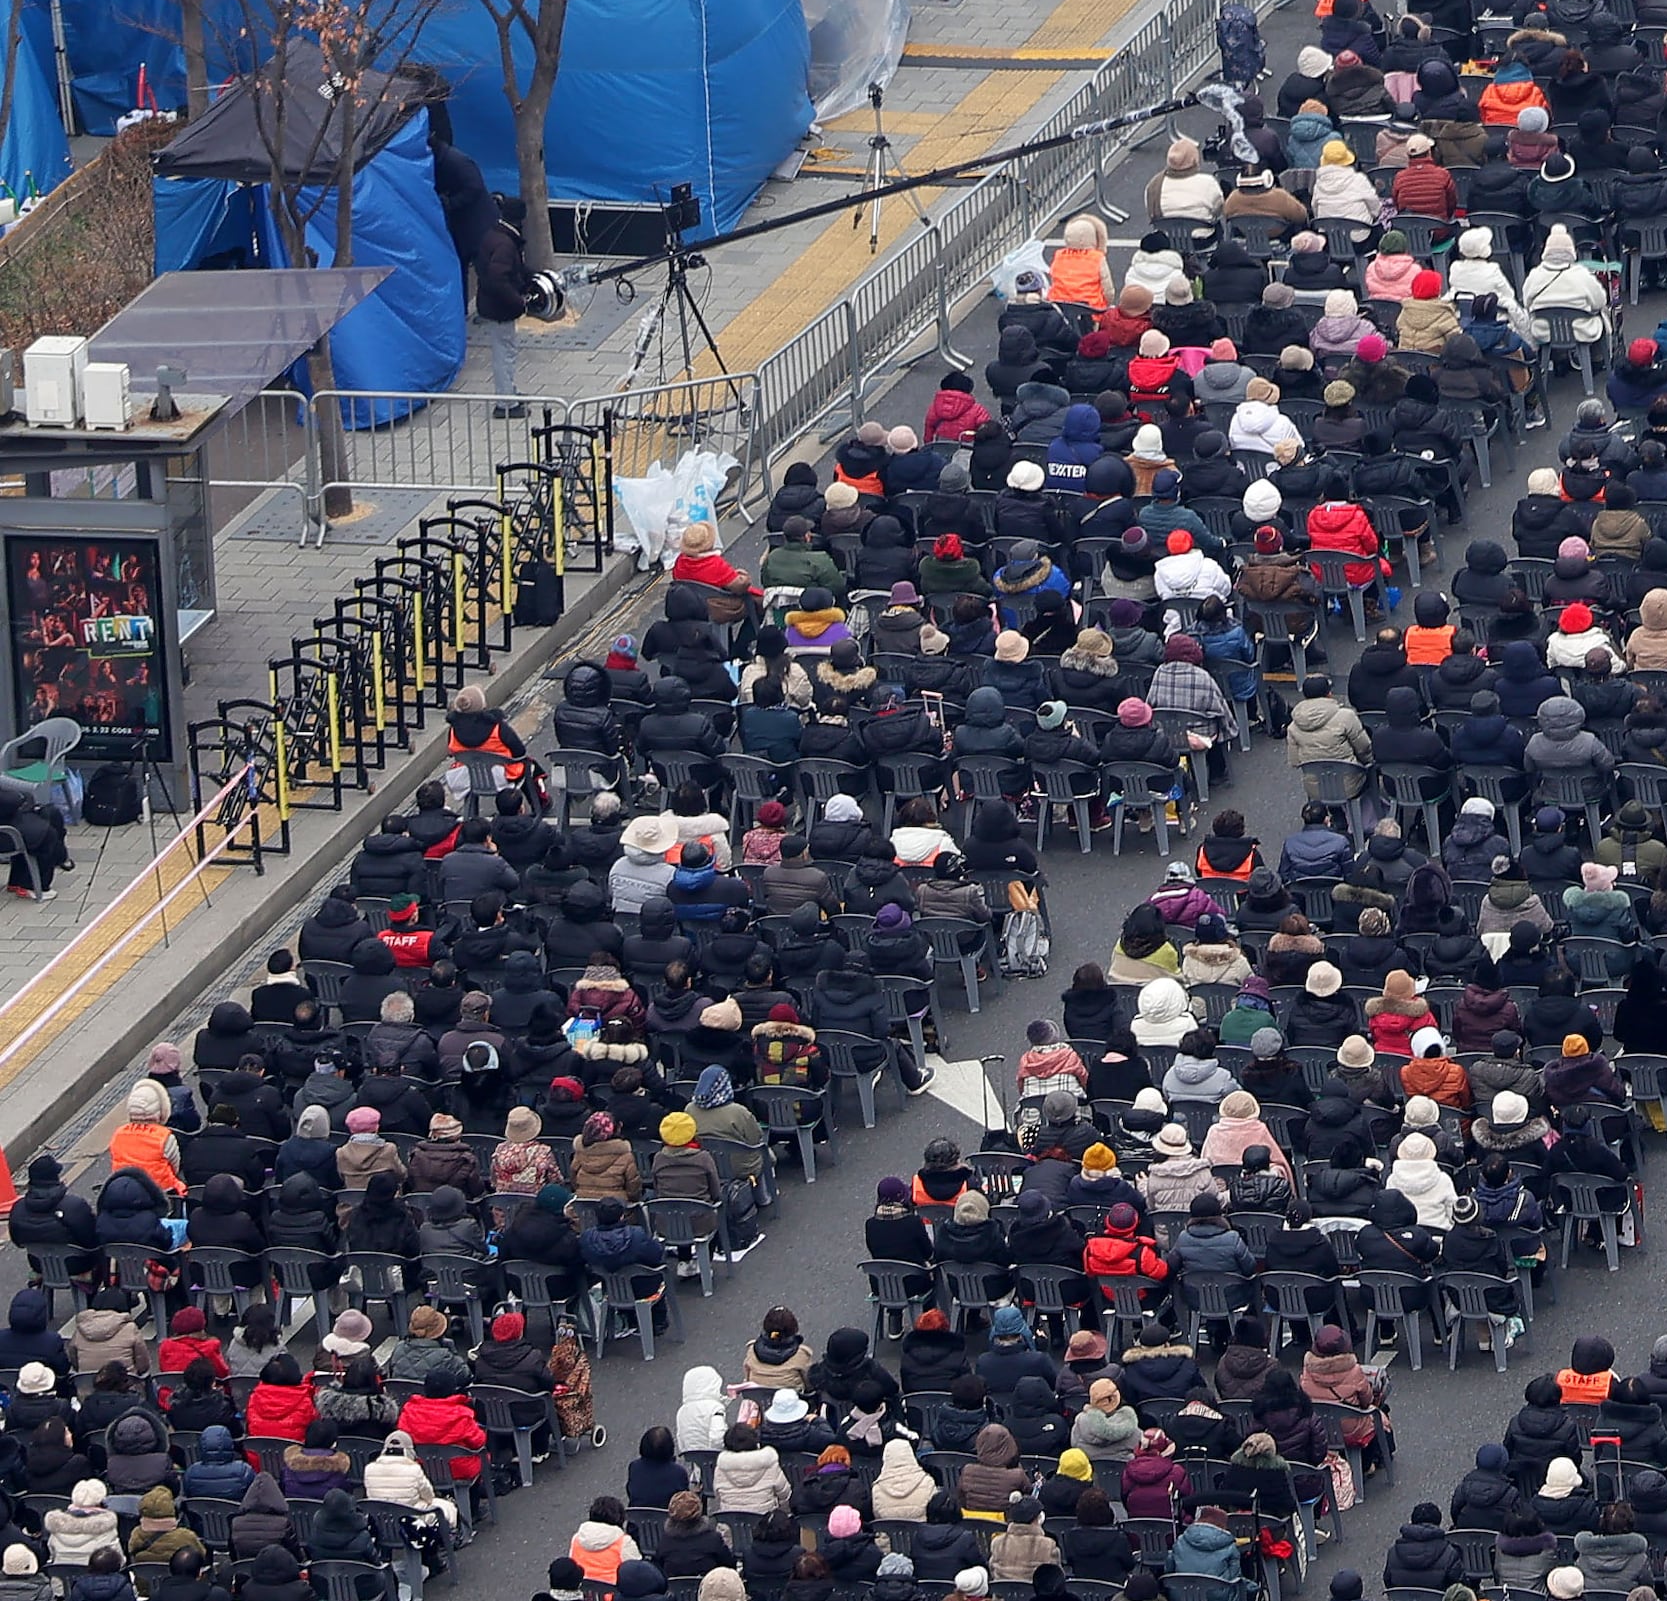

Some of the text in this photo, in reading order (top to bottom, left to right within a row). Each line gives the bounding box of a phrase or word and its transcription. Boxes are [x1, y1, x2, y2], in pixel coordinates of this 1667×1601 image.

[83, 618, 151, 644] RENT
[383, 936, 418, 947] STAFF
[1564, 1374, 1600, 1385] STAFF
